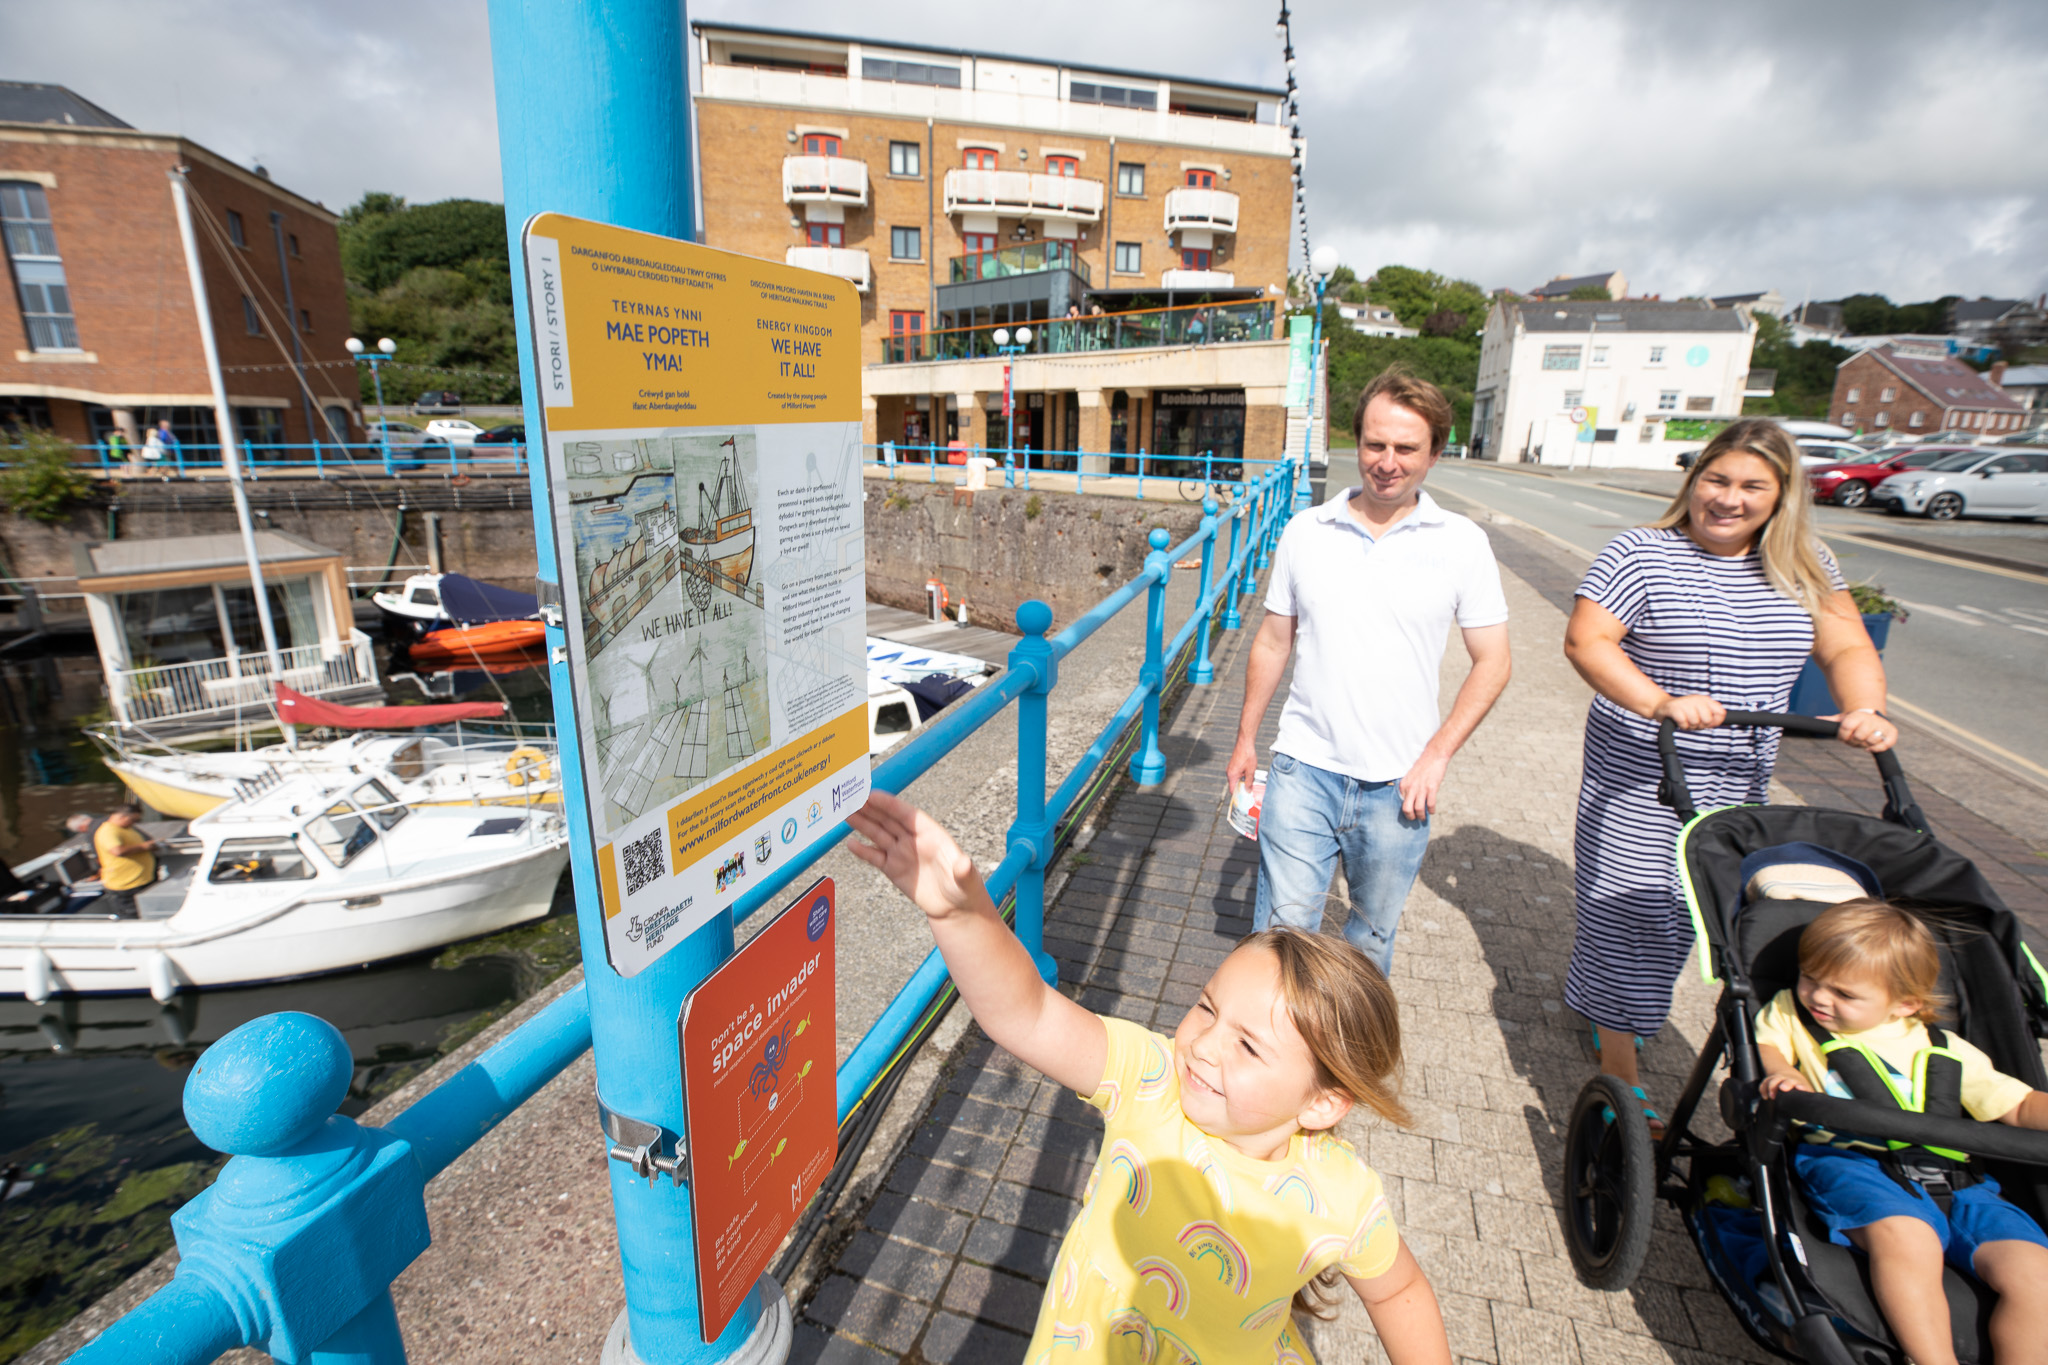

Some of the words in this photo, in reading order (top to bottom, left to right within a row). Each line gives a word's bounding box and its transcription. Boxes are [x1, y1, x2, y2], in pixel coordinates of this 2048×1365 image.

[571, 246, 620, 263] DARGANFOD
[622, 257, 686, 274] ABERDAUGLEDDAU
[687, 268, 704, 278] TRWY
[706, 272, 727, 282] GYFRES
[592, 262, 598, 271] O
[601, 263, 636, 277] LWYBRAU
[638, 271, 669, 283] CERDDED
[671, 276, 714, 290] TREFTADAETH
[542, 269, 558, 326] STORY
[750, 280, 775, 290] DISCOVER
[776, 284, 796, 294] MILFORD
[797, 289, 812, 298] HAVEN
[823, 294, 835, 302] SERIES
[769, 293, 791, 303] HERITAGE
[792, 297, 813, 307] WALKING
[814, 301, 827, 309] TRAILS
[612, 299, 670, 318] TEYRNAS
[674, 307, 702, 322] YNNI
[607, 321, 644, 342] MAE
[648, 325, 709, 348] POPETH
[757, 319, 791, 333] ENERGY
[794, 323, 832, 337] KINGDOM
[771, 338, 791, 354] WE
[793, 340, 821, 357] HAVE
[549, 340, 564, 390] STORI
[643, 352, 682, 372] YMA!
[780, 361, 791, 377] IT
[793, 363, 815, 378] ALL!
[633, 402, 647, 410] ifanc
[649, 402, 696, 412] Aberdaugleddau
[665, 391, 675, 400] gan
[677, 390, 689, 398] bobl
[768, 391, 786, 400] Created
[787, 392, 792, 401] by
[814, 393, 827, 401] people
[642, 617, 661, 642] WE
[665, 608, 693, 635] HAVE
[697, 607, 706, 625] IT
[712, 602, 732, 622] ALL!
[680, 810, 704, 826] ddarllen
[705, 807, 708, 815] y
[709, 797, 726, 809] stori'n
[728, 786, 742, 798] llawn
[742, 774, 764, 791] sganiwch
[765, 771, 768, 779] y
[769, 765, 778, 775] cod
[778, 759, 786, 768] QR
[787, 756, 796, 764] neu
[796, 747, 812, 760] cliciwch
[822, 733, 836, 745] ddolen
[678, 830, 688, 840] For
[690, 825, 699, 834] the
[700, 818, 709, 828] full
[710, 810, 724, 822] story
[725, 802, 736, 812] scan
[738, 795, 746, 805] the
[747, 788, 756, 798] QR
[756, 781, 768, 792] code
[769, 778, 774, 786] or
[776, 771, 784, 782] visit
[786, 766, 794, 776] the
[644, 896, 692, 935] DREFTADAETH
[644, 906, 668, 927] CRONFA
[646, 916, 679, 944] HERITAGE
[646, 934, 664, 951] FUND
[712, 1012, 762, 1074] space
[768, 952, 821, 1018] invader
[712, 1021, 734, 1051] Don't
[737, 1010, 748, 1025] be
[750, 1003, 754, 1013] a
[715, 1233, 724, 1248] Be
[726, 1214, 739, 1235] safe
[716, 1244, 725, 1260] Be
[727, 1200, 758, 1245] courteous
[716, 1256, 726, 1271] Be
[727, 1232, 742, 1256] kind
